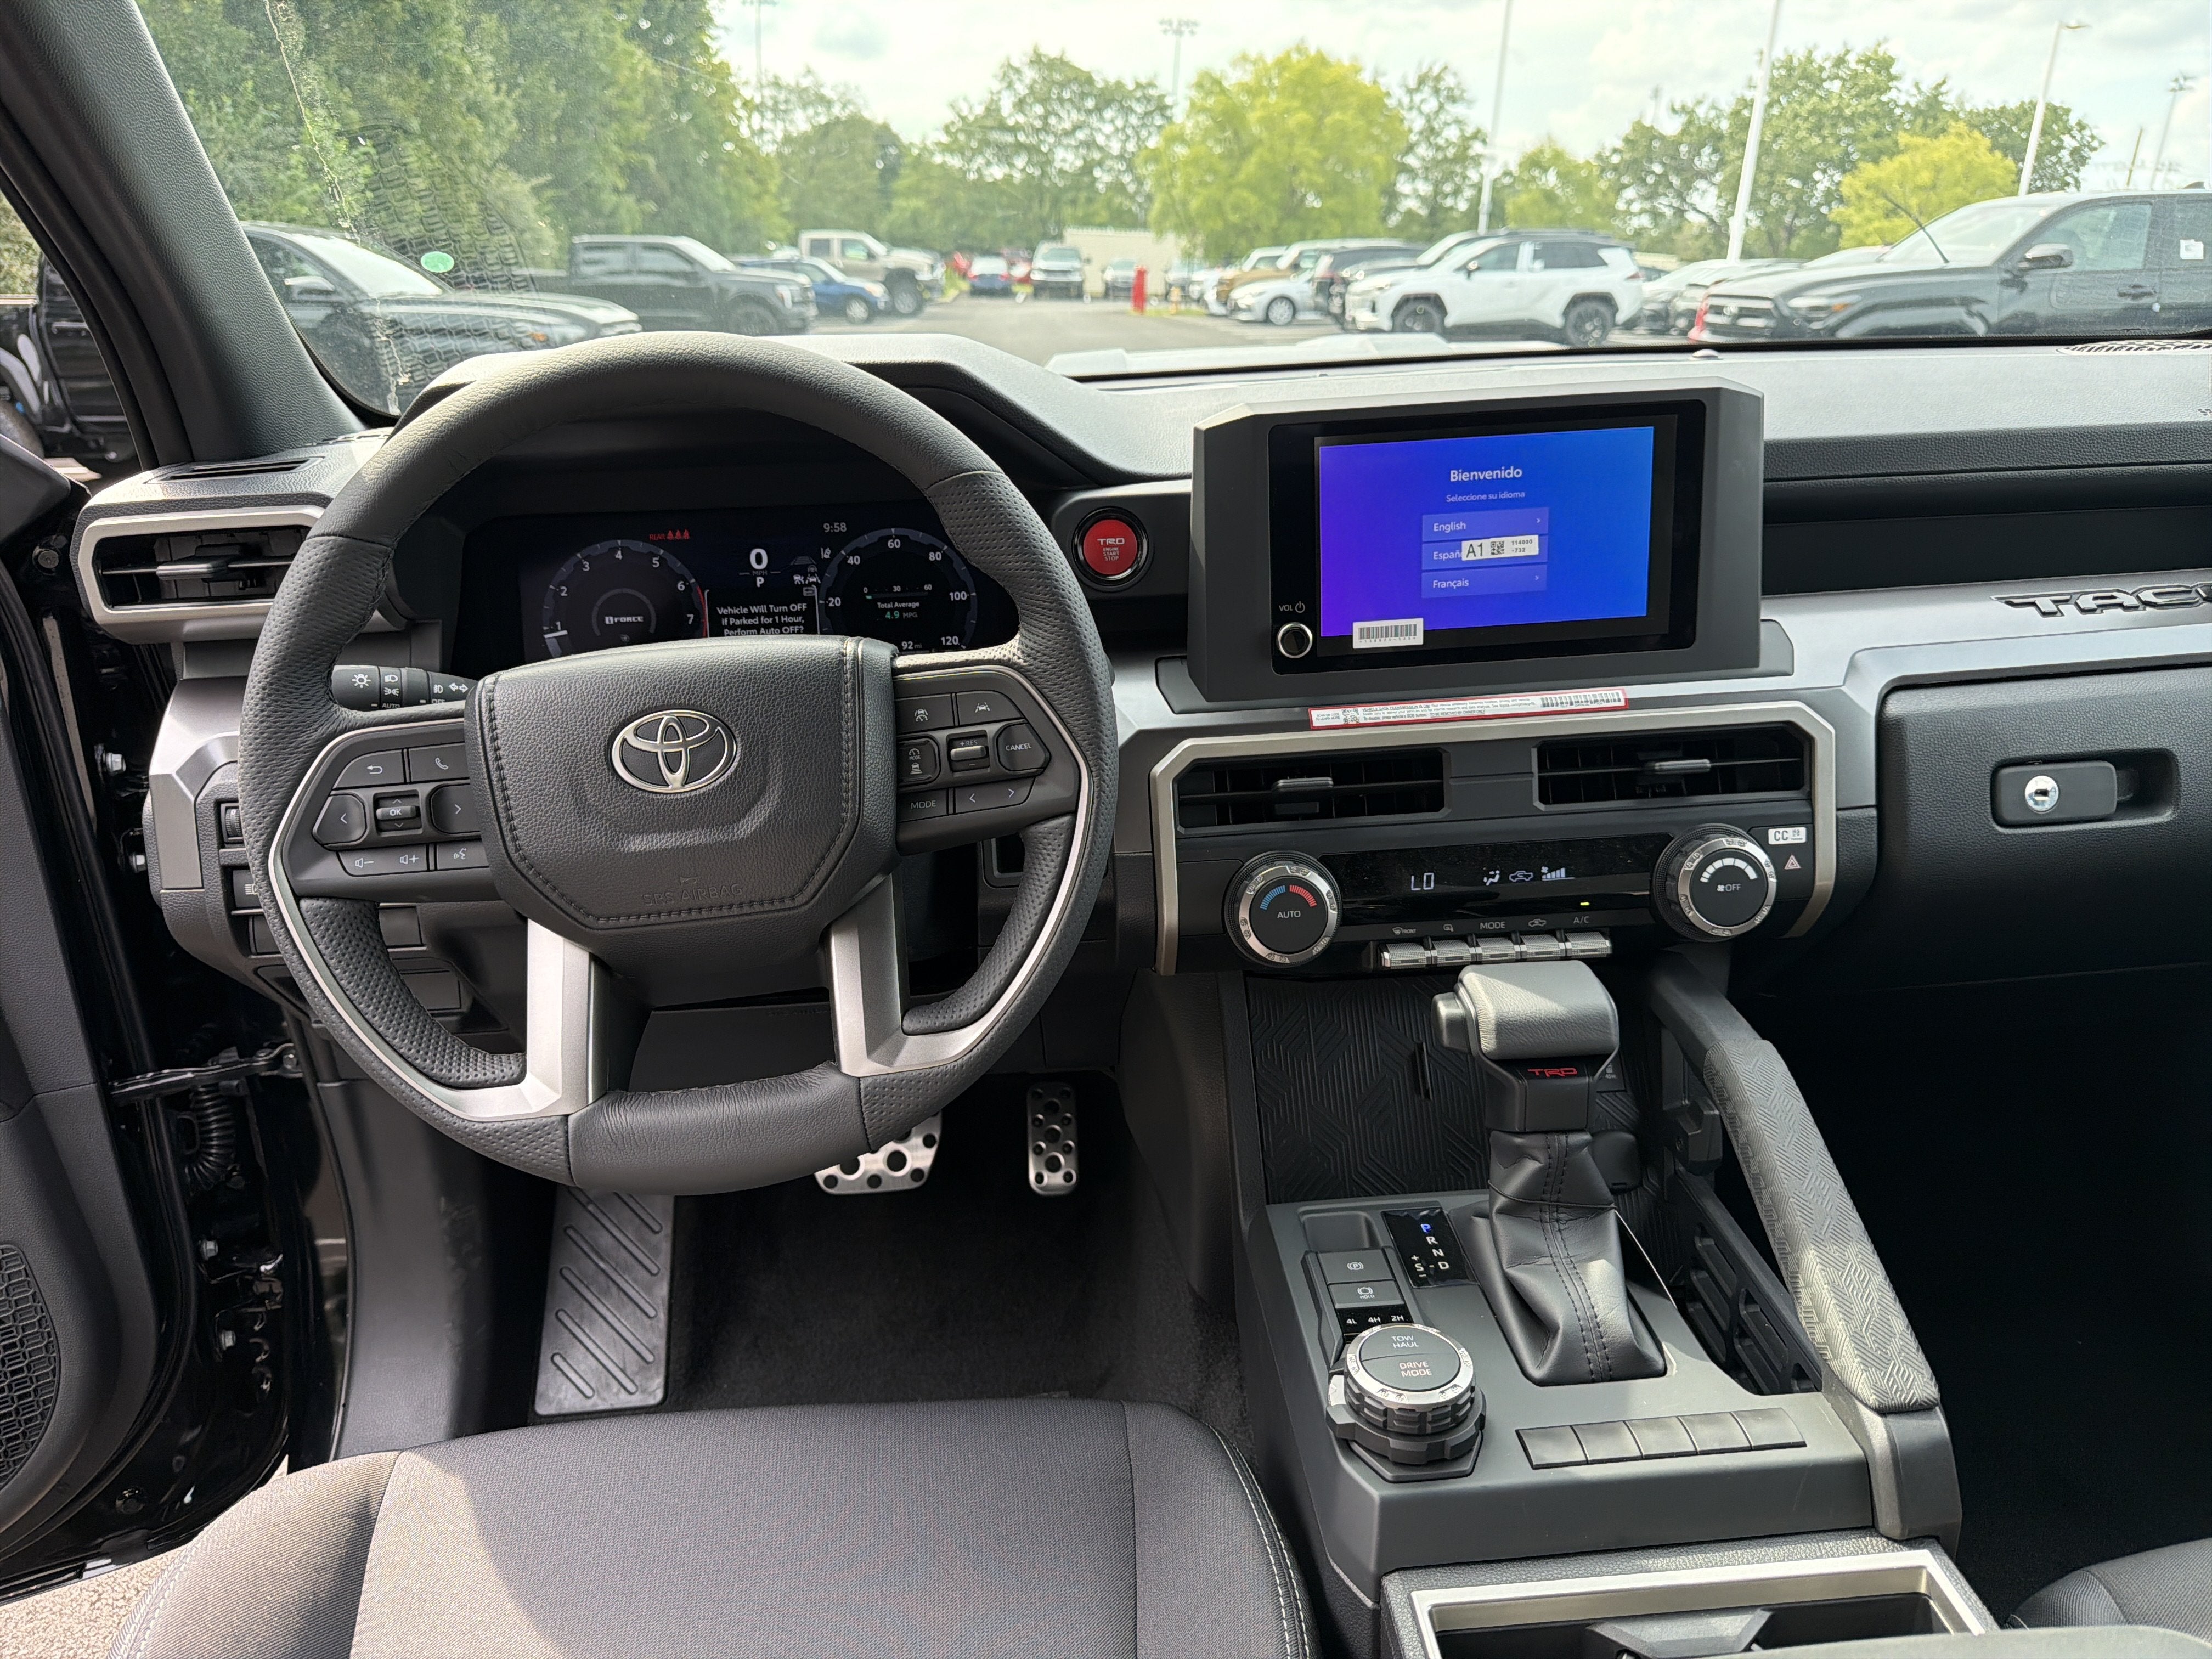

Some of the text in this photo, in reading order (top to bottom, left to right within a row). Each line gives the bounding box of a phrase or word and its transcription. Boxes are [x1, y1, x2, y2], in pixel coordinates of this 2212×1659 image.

[1450, 466, 1522, 482] Bienvenido
[1446, 493, 1487, 503] Seleccione
[823, 522, 847, 533] 9:58
[1434, 521, 1466, 533] English
[888, 539, 901, 548] 60
[615, 550, 623, 560] 4
[1466, 543, 1483, 558] A1
[750, 548, 768, 569] 0
[847, 555, 860, 565] 40
[929, 551, 942, 561] 80
[583, 561, 590, 571] 3
[652, 557, 659, 568] 5
[677, 581, 685, 591] 6
[757, 577, 764, 587] P
[1433, 578, 1469, 589] Français
[560, 586, 568, 596] 2
[949, 591, 967, 601] 100
[828, 597, 842, 607] 20
[1991, 583, 2212, 617] TAC
[716, 603, 808, 615] Vehicle Will Turn OFF
[687, 614, 694, 624] 7
[730, 616, 759, 625] Parked
[761, 616, 774, 624] for
[781, 614, 804, 624] Hour,
[885, 611, 900, 619] 4.9
[556, 621, 562, 631] 1
[724, 625, 804, 636] Perform Auto OFF?
[901, 641, 913, 650] 92
[940, 636, 959, 646] 120
[1006, 742, 1032, 752] CANCEL
[911, 800, 936, 809] MODE
[389, 808, 402, 816] OK
[1774, 830, 1788, 842] CC
[1410, 872, 1435, 891] LO
[642, 884, 743, 906] SRS AIRBAG
[1277, 910, 1301, 919] AUTO
[1480, 921, 1506, 929] MODE
[1573, 916, 1590, 924] A/C
[1527, 1068, 1578, 1077] TRD
[1420, 1223, 1432, 1233] P
[1426, 1236, 1438, 1245] R
[1432, 1249, 1444, 1257] N
[1399, 1361, 1429, 1369] DRIVE
[1401, 1368, 1432, 1378] MODE
